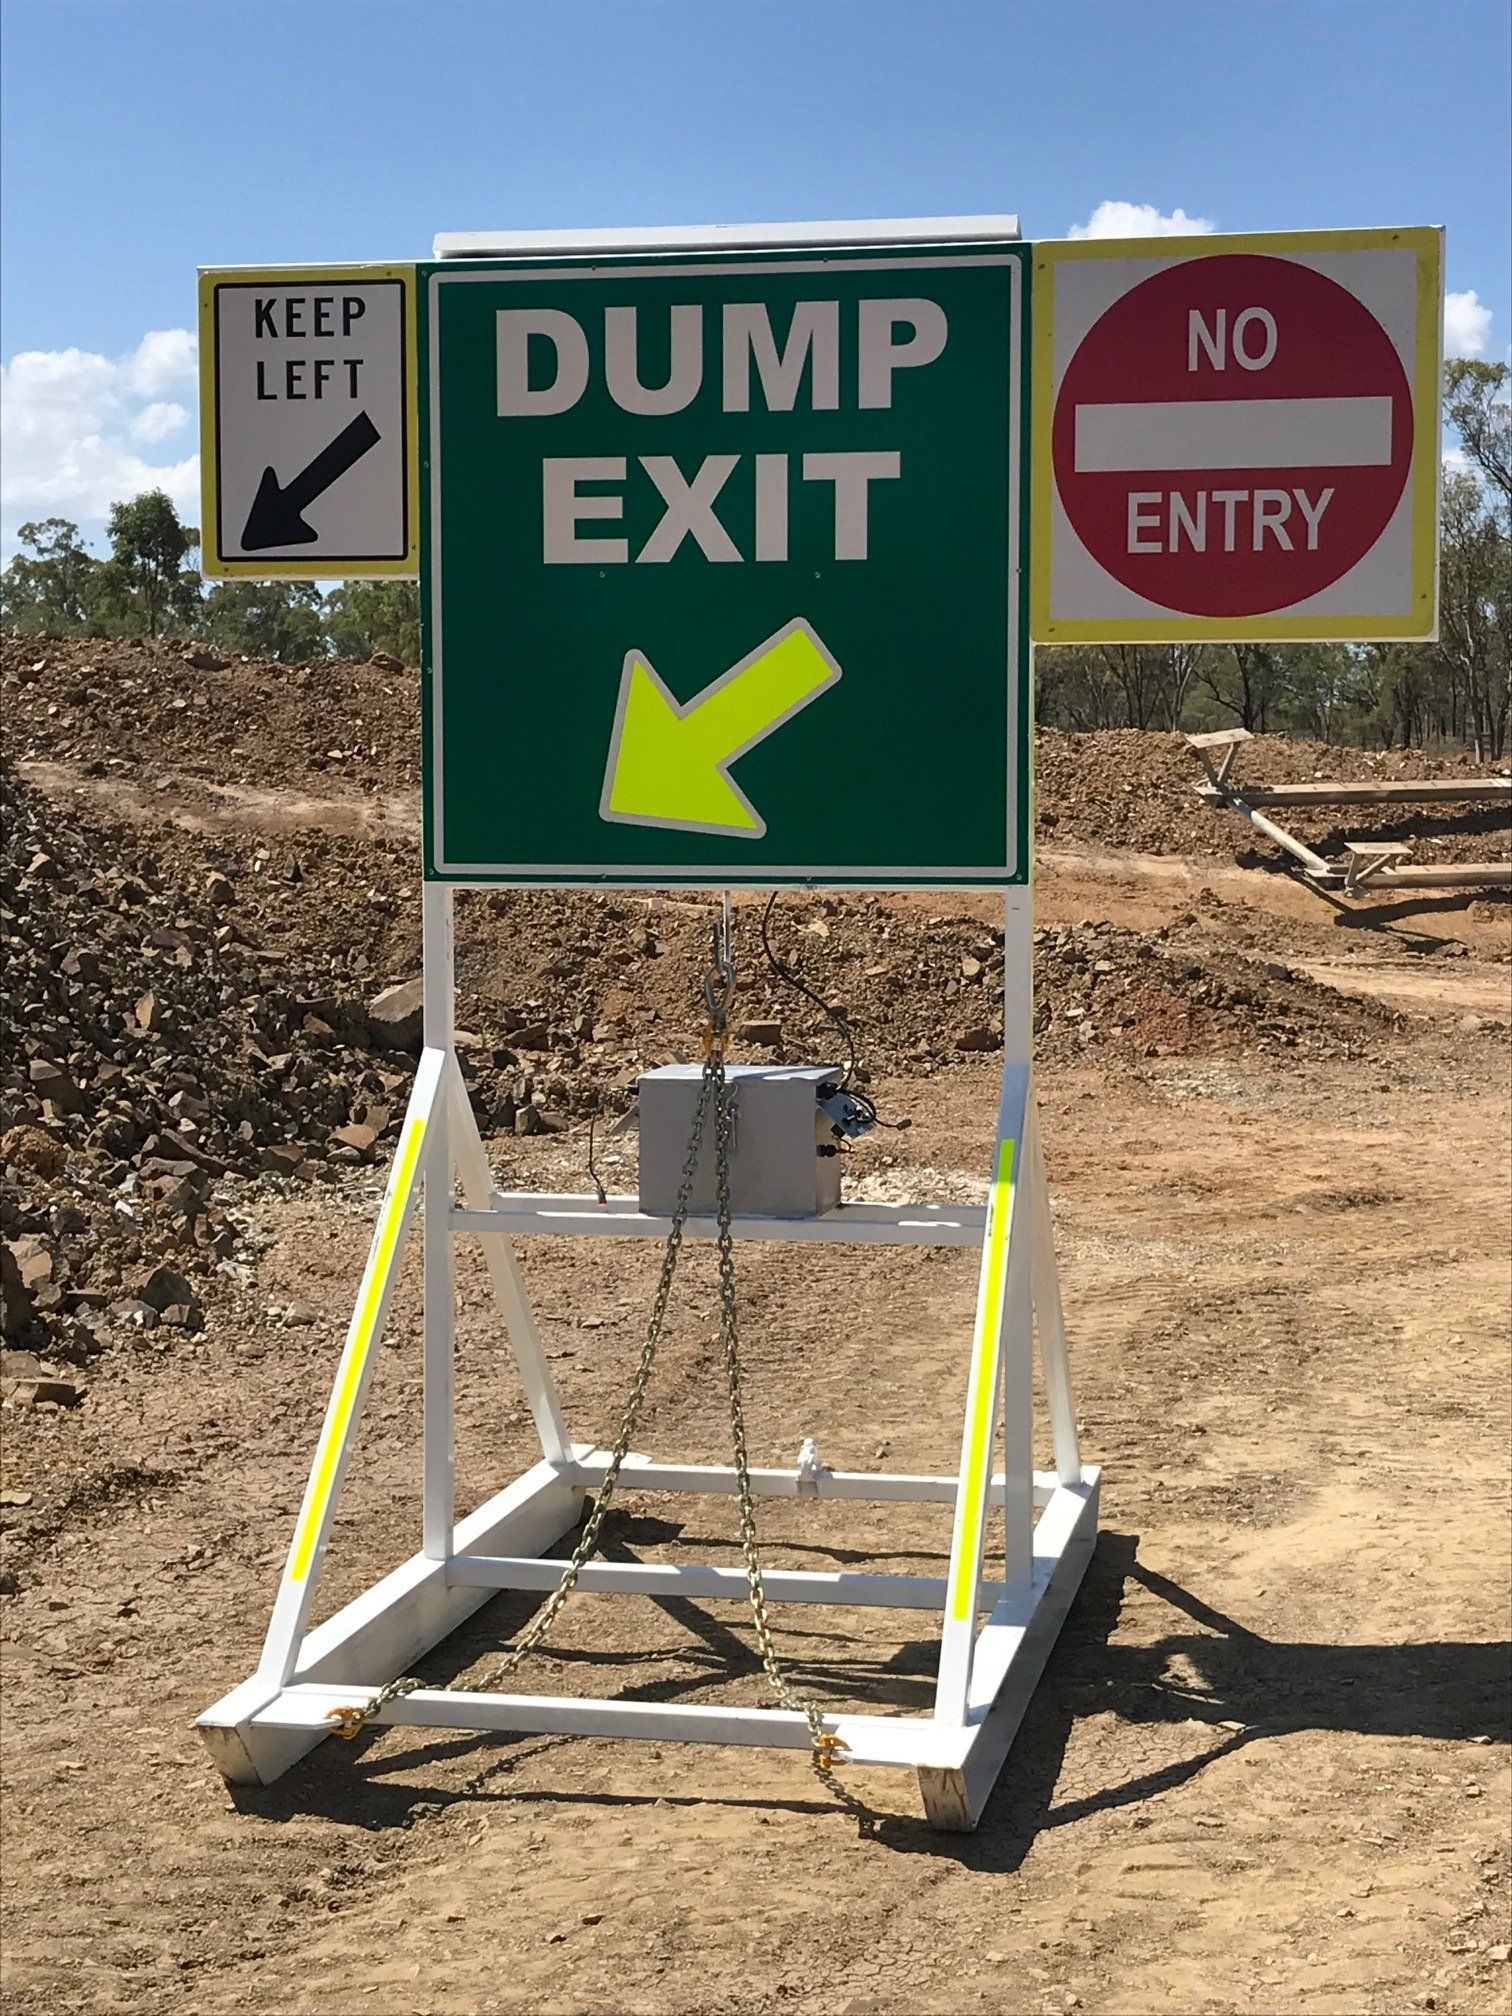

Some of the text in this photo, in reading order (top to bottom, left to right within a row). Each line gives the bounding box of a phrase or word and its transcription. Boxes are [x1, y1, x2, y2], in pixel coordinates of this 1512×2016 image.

[255, 296, 366, 338] KEEP
[1187, 307, 1278, 372] NO
[256, 359, 364, 400] LEFT
[496, 298, 948, 417] DUMP
[543, 451, 901, 564] EXIT
[1127, 488, 1335, 555] ENTRY
